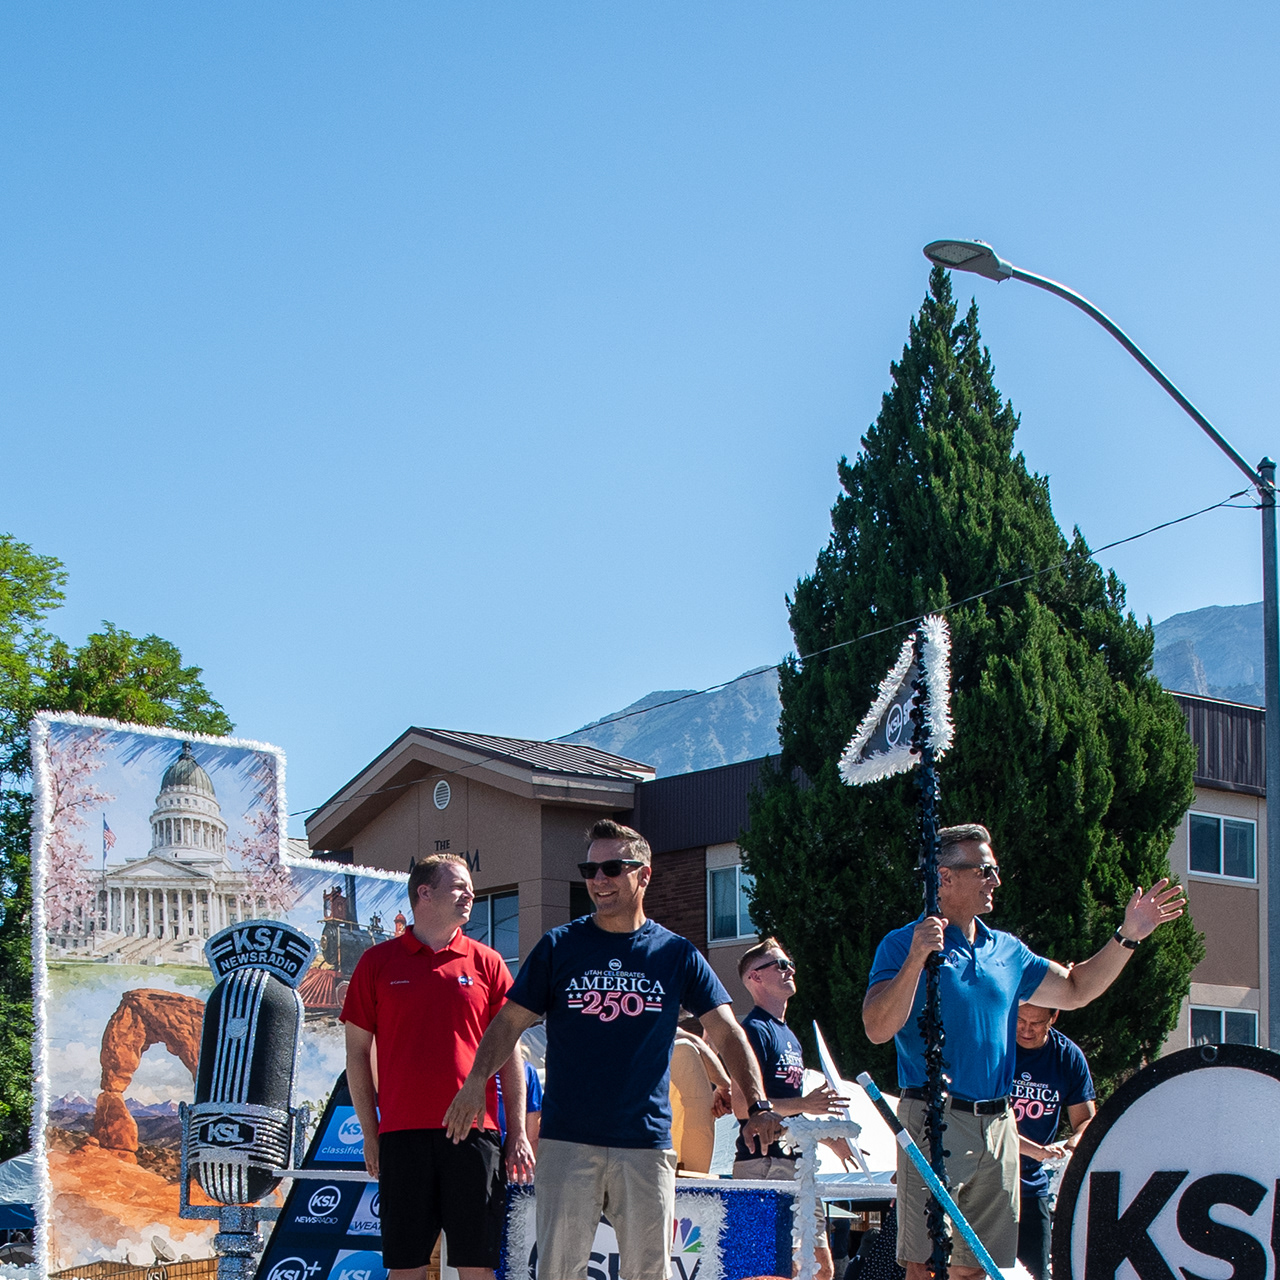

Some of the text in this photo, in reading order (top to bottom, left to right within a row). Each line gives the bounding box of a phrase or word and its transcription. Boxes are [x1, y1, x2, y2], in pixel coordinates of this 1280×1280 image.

[435, 839, 451, 851] THE
[232, 927, 286, 955] KSL
[220, 951, 298, 974] NEWSRADIO
[603, 970, 646, 979] CELEBRATES
[565, 976, 666, 995] AMERICA
[581, 990, 644, 1022] 250
[1010, 1084, 1060, 1102] ERICA
[1013, 1098, 1044, 1122] 50
[207, 1122, 245, 1144] KSL
[340, 1122, 364, 1137] KS
[311, 1194, 338, 1208] KSL
[294, 1215, 339, 1225] NEWSRADIO
